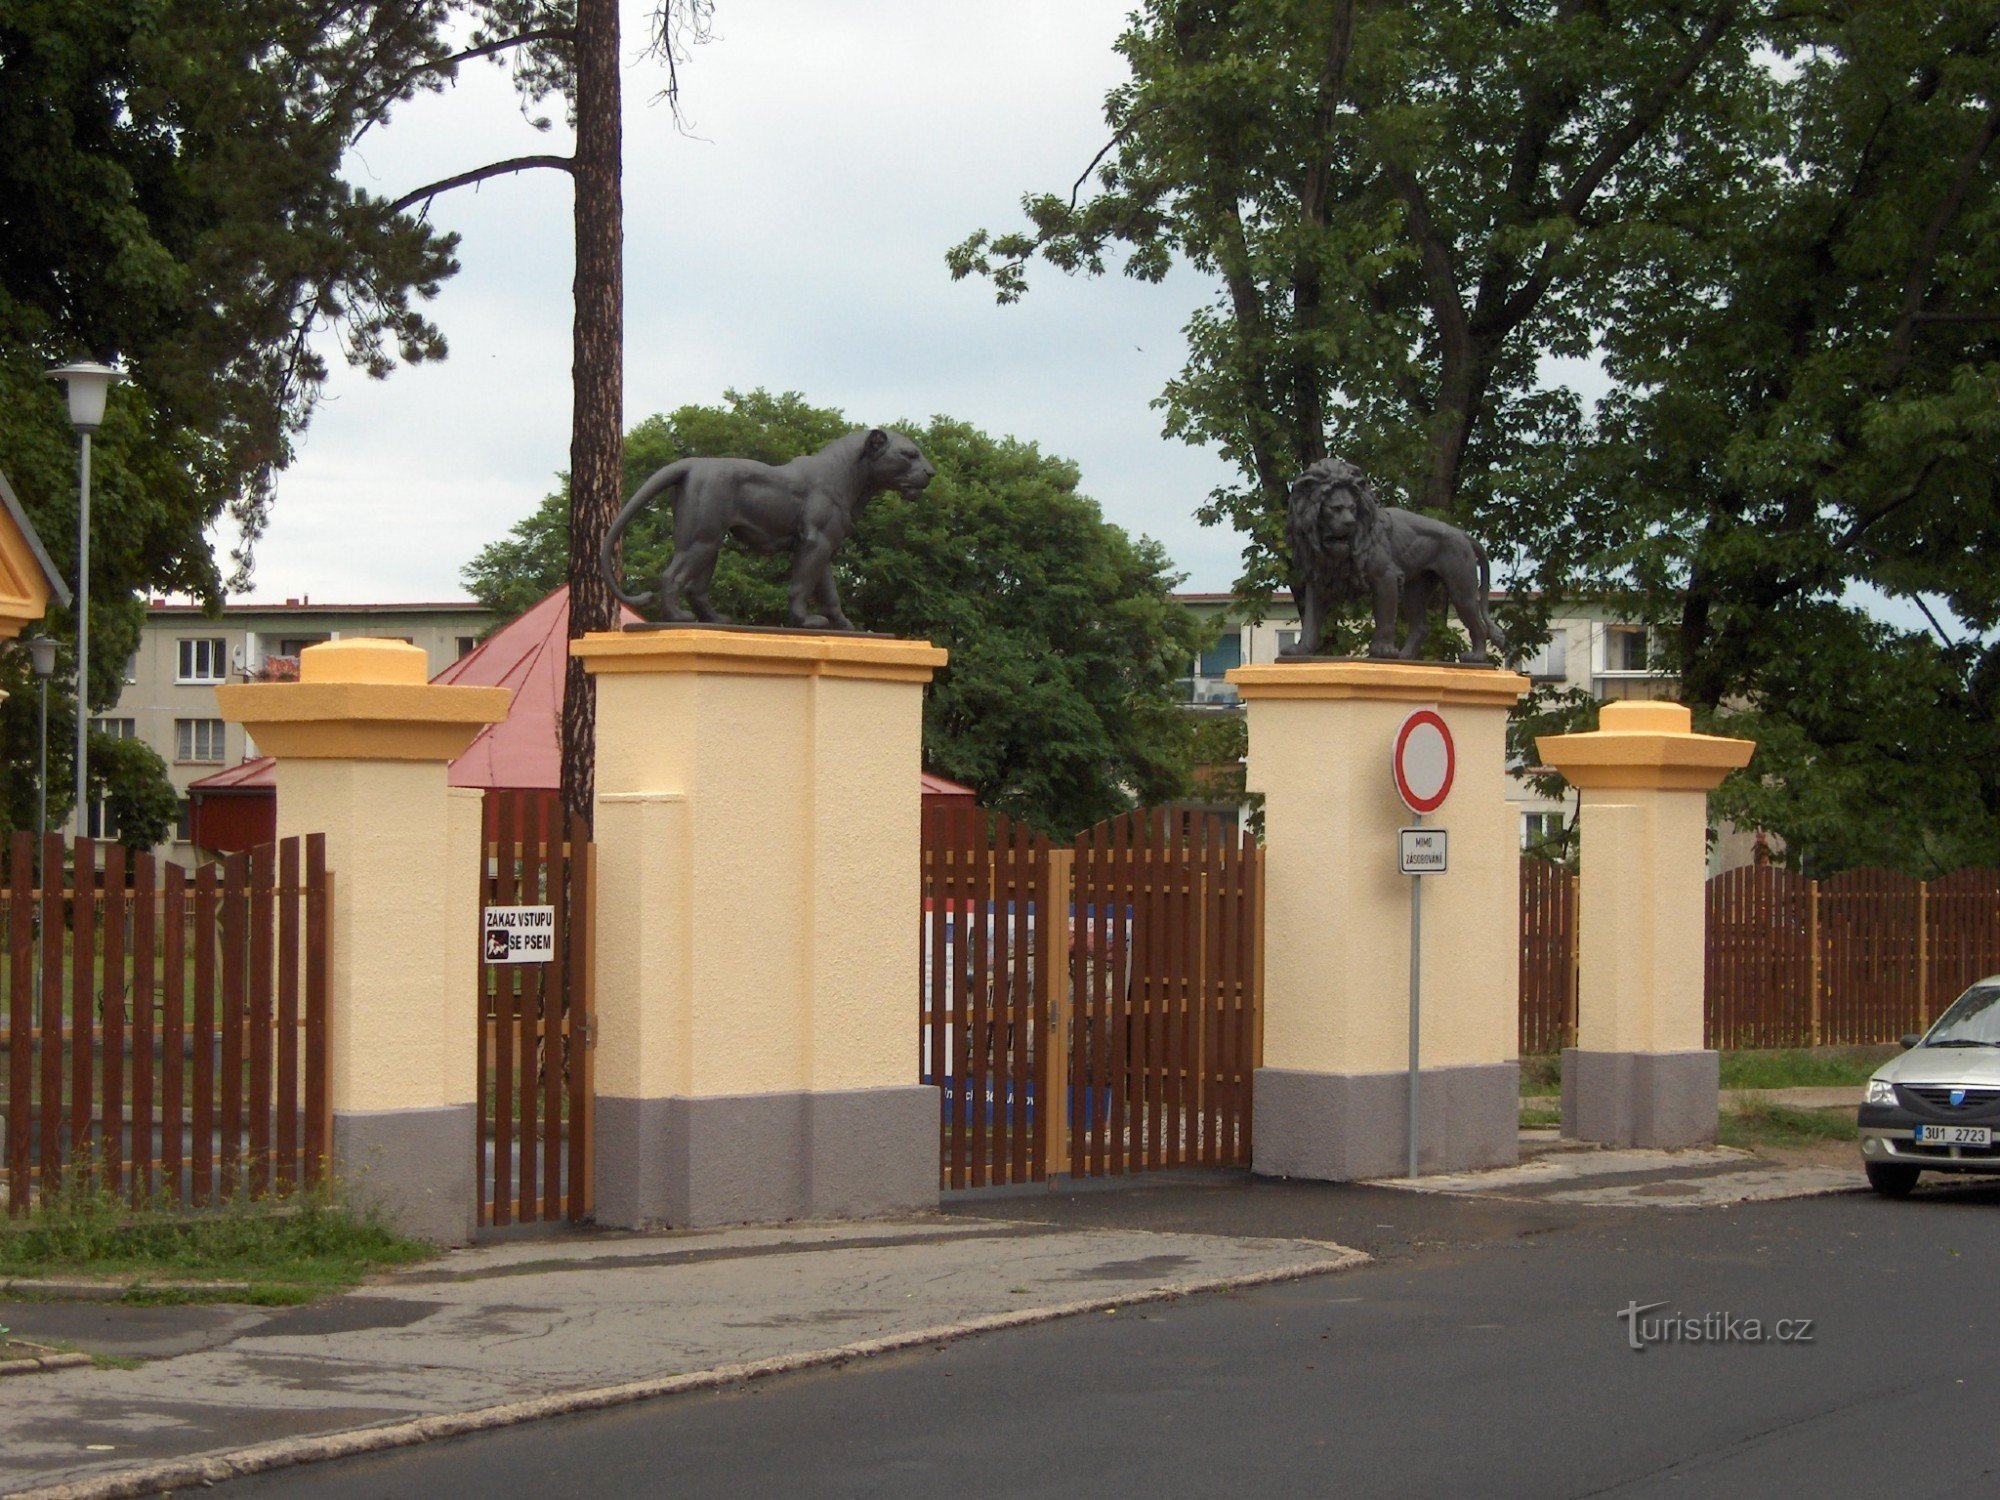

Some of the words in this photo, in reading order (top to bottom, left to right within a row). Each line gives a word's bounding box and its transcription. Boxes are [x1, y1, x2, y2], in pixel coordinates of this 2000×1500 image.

[1415, 837, 1433, 848] MIMO
[487, 910, 517, 927] ZÁKAZ
[518, 912, 552, 927] VSTUPU
[509, 935, 522, 950] SE
[524, 935, 551, 950] PSEM
[1925, 1127, 1946, 1140] 3U1
[1955, 1128, 1985, 1143] 2723
